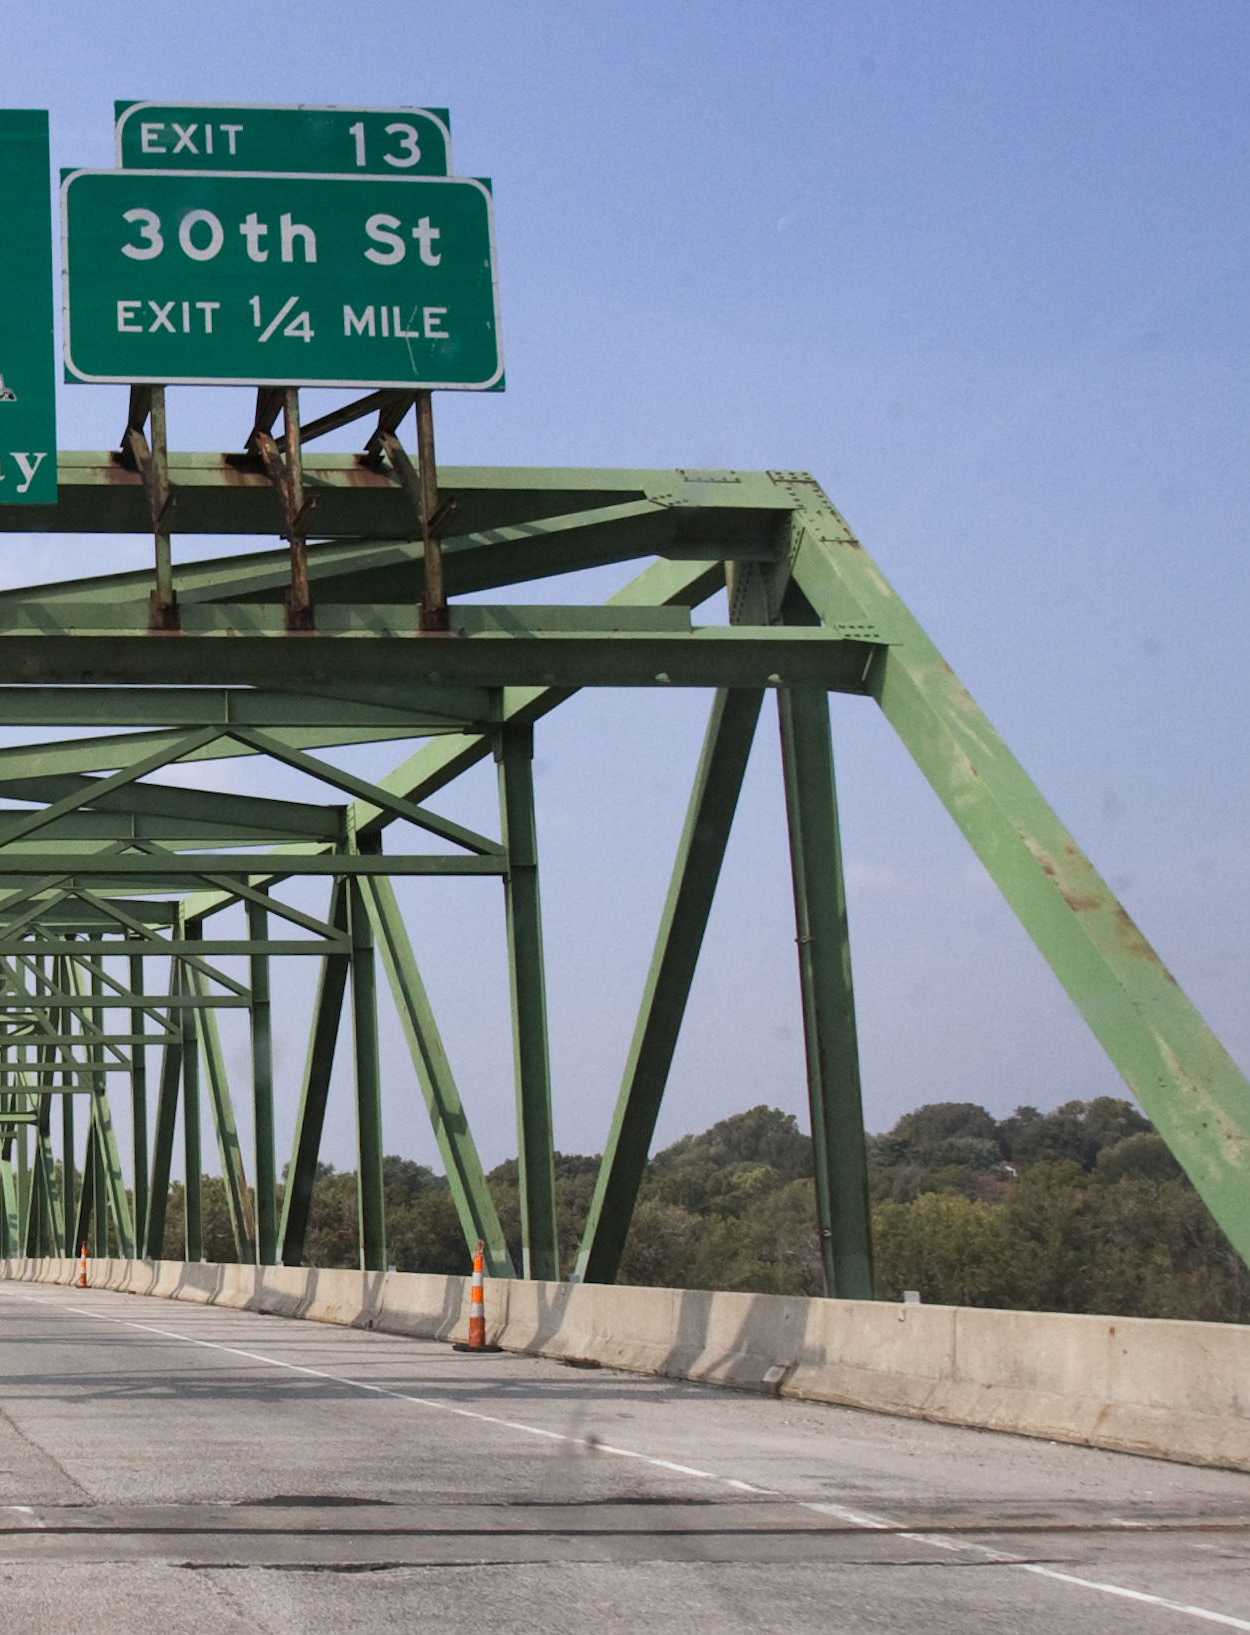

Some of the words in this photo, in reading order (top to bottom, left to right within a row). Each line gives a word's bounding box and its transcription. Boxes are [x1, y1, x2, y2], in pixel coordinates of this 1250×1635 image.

[141, 123, 244, 154] EXIT
[349, 122, 421, 167] 13
[121, 208, 317, 262] 30th
[364, 213, 441, 266] St
[117, 300, 220, 333] EXIT
[343, 305, 449, 338] MILE
